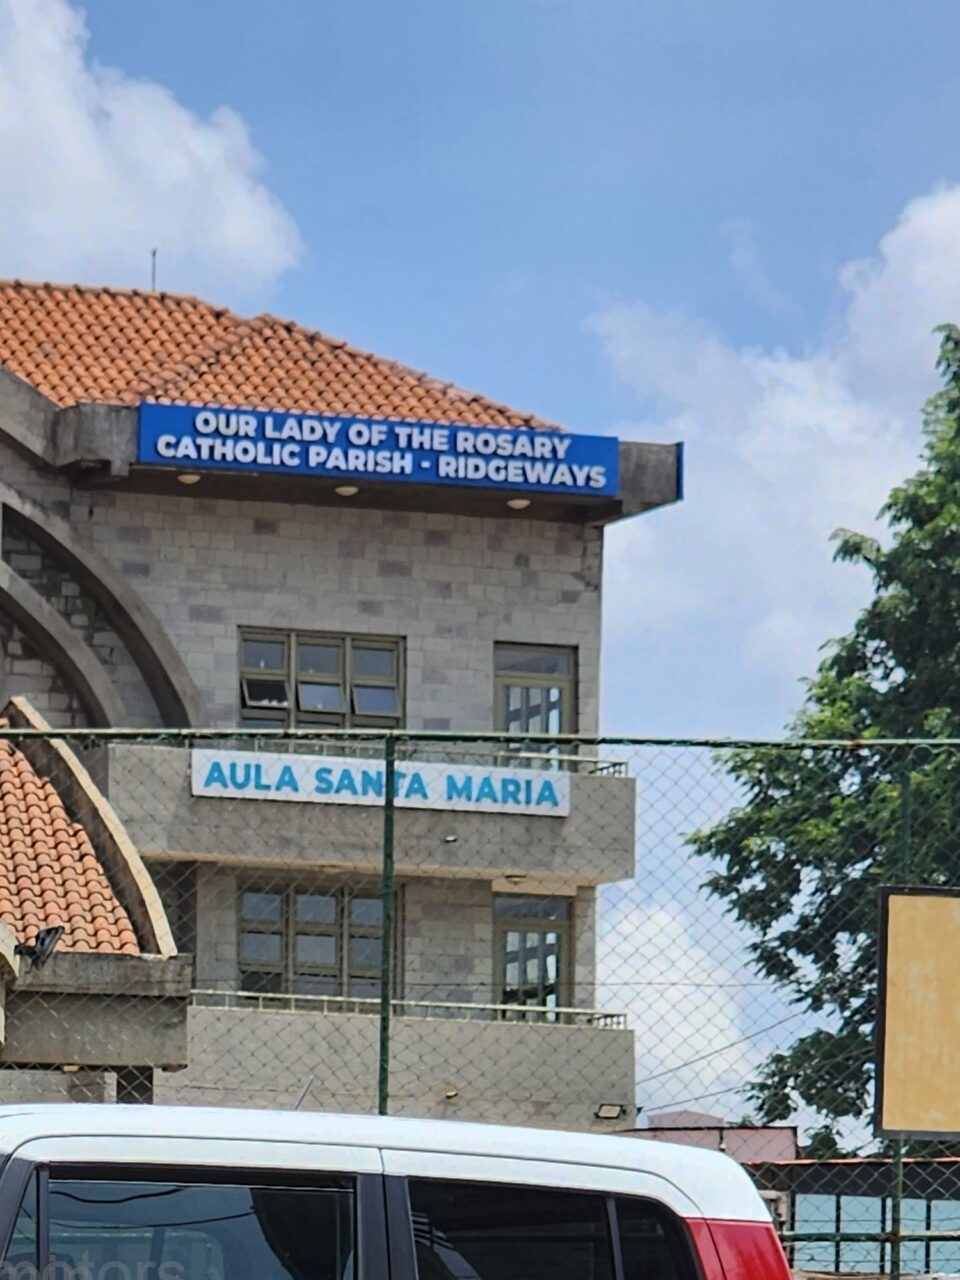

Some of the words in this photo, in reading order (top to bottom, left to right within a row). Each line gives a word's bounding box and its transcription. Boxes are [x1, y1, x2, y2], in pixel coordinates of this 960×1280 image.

[195, 411, 257, 437] OUR
[265, 416, 341, 443] LADY
[348, 423, 387, 446] OF
[395, 427, 449, 451] THE
[457, 431, 571, 459] ROSARY
[157, 434, 301, 467] CATHOLIC
[308, 445, 413, 475] PARISH
[439, 455, 607, 488] RIDGEWAYS
[204, 761, 299, 792] AULA
[314, 767, 429, 799] SANTA
[446, 775, 559, 807] MARIA
